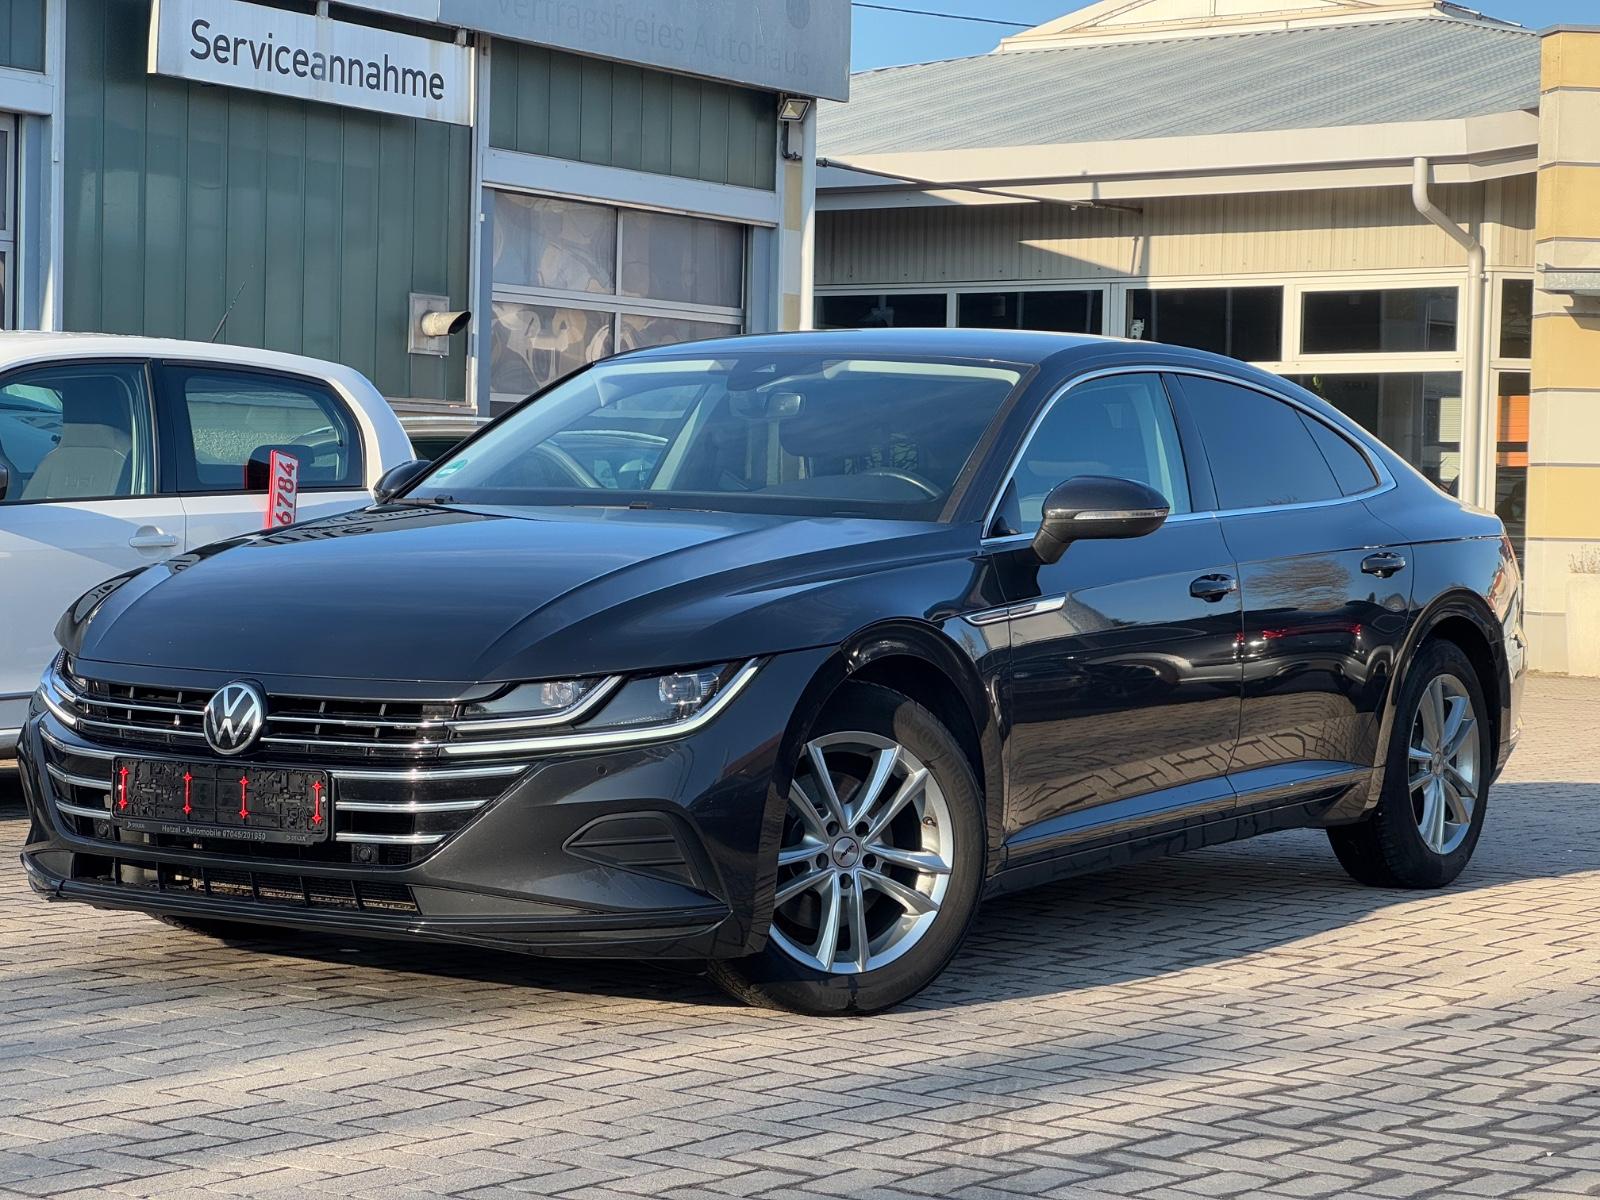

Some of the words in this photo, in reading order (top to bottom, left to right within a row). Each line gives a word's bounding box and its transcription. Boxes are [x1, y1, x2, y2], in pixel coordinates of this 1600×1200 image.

[189, 17, 445, 101] Serviceannahme
[693, 24, 809, 77] Autohaus
[275, 461, 296, 525] 6784
[204, 685, 262, 754] VW
[185, 827, 221, 838] Automobile
